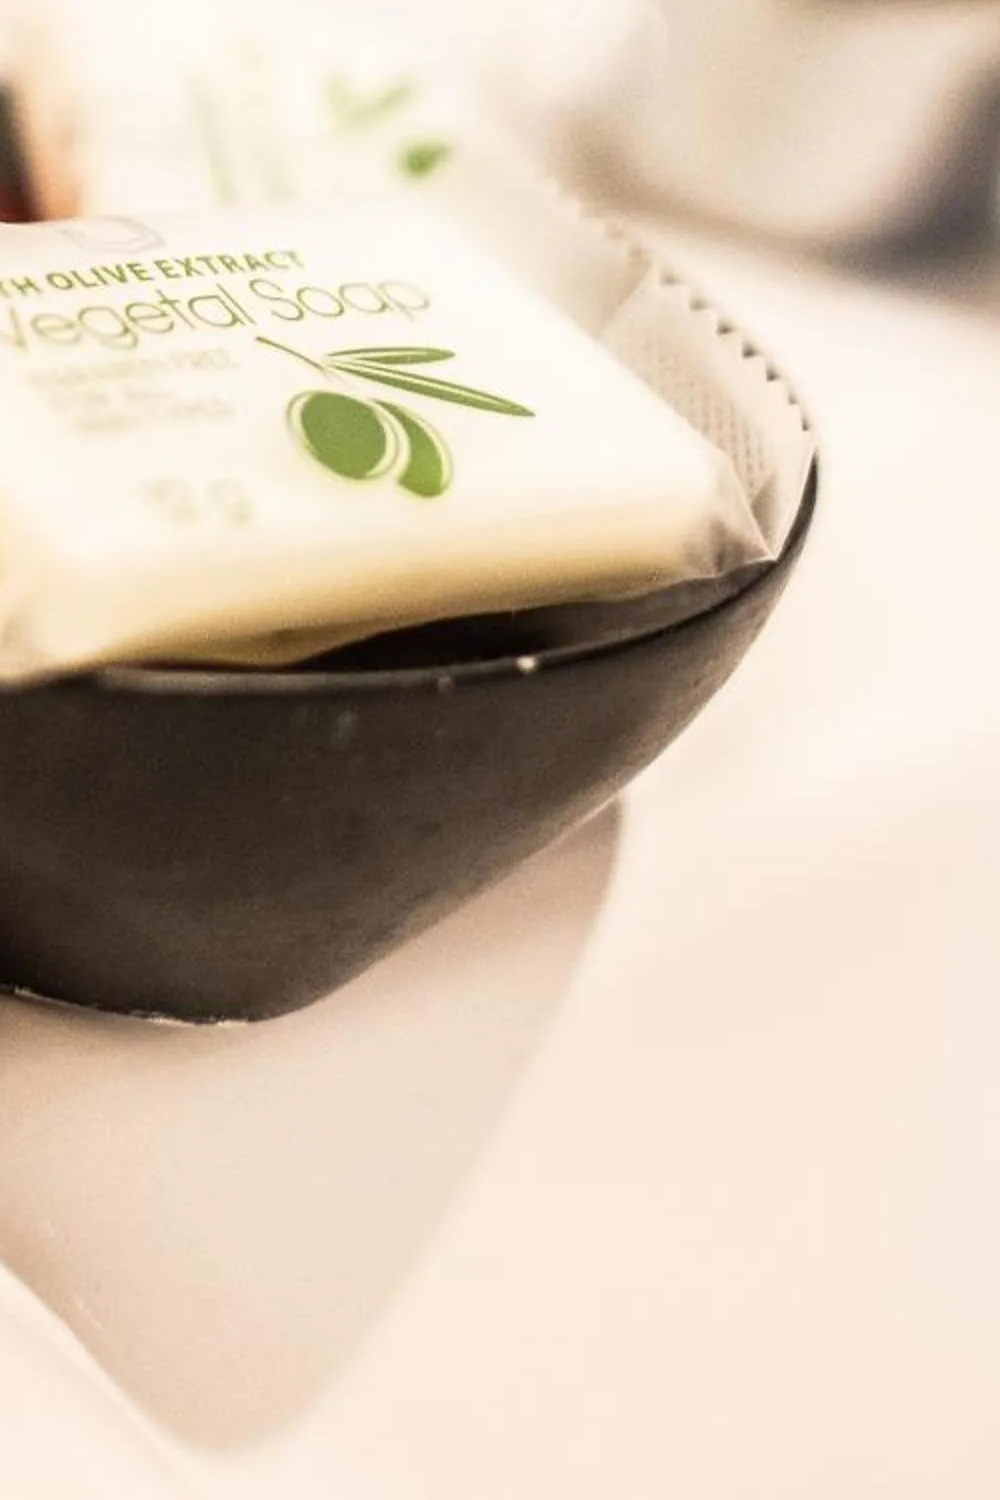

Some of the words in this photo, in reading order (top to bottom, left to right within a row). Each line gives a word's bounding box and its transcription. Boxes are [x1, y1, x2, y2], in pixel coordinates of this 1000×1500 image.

[50, 260, 154, 294] OLIVE
[160, 249, 306, 280] EXTRACT
[248, 278, 431, 323] Soap
